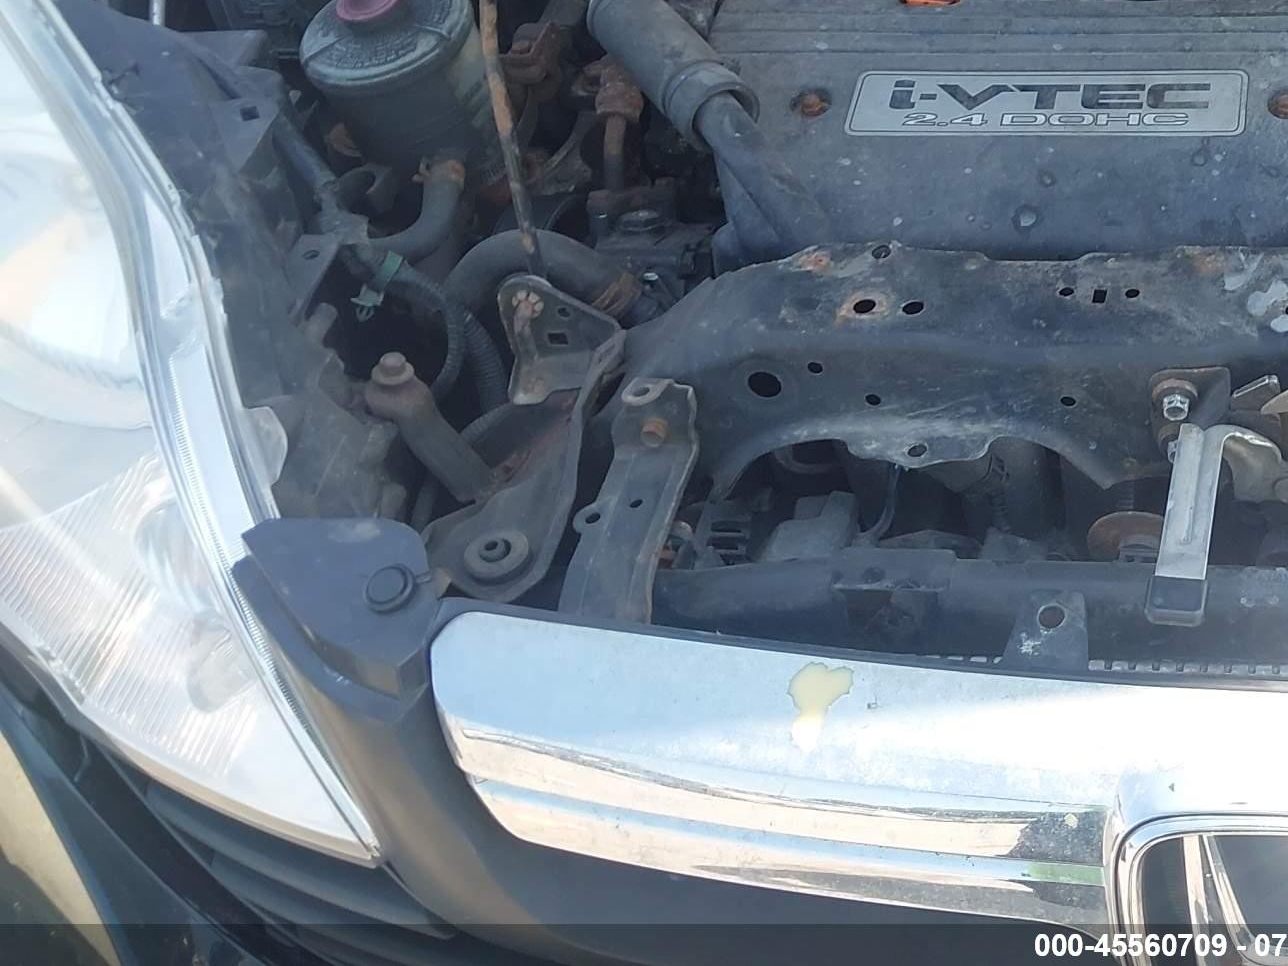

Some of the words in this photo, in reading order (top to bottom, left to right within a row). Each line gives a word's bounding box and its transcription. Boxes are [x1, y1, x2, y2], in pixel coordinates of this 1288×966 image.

[888, 79, 1212, 110] i-VTEC
[902, 112, 988, 127] 2.4
[1000, 112, 1189, 127] DOHC
